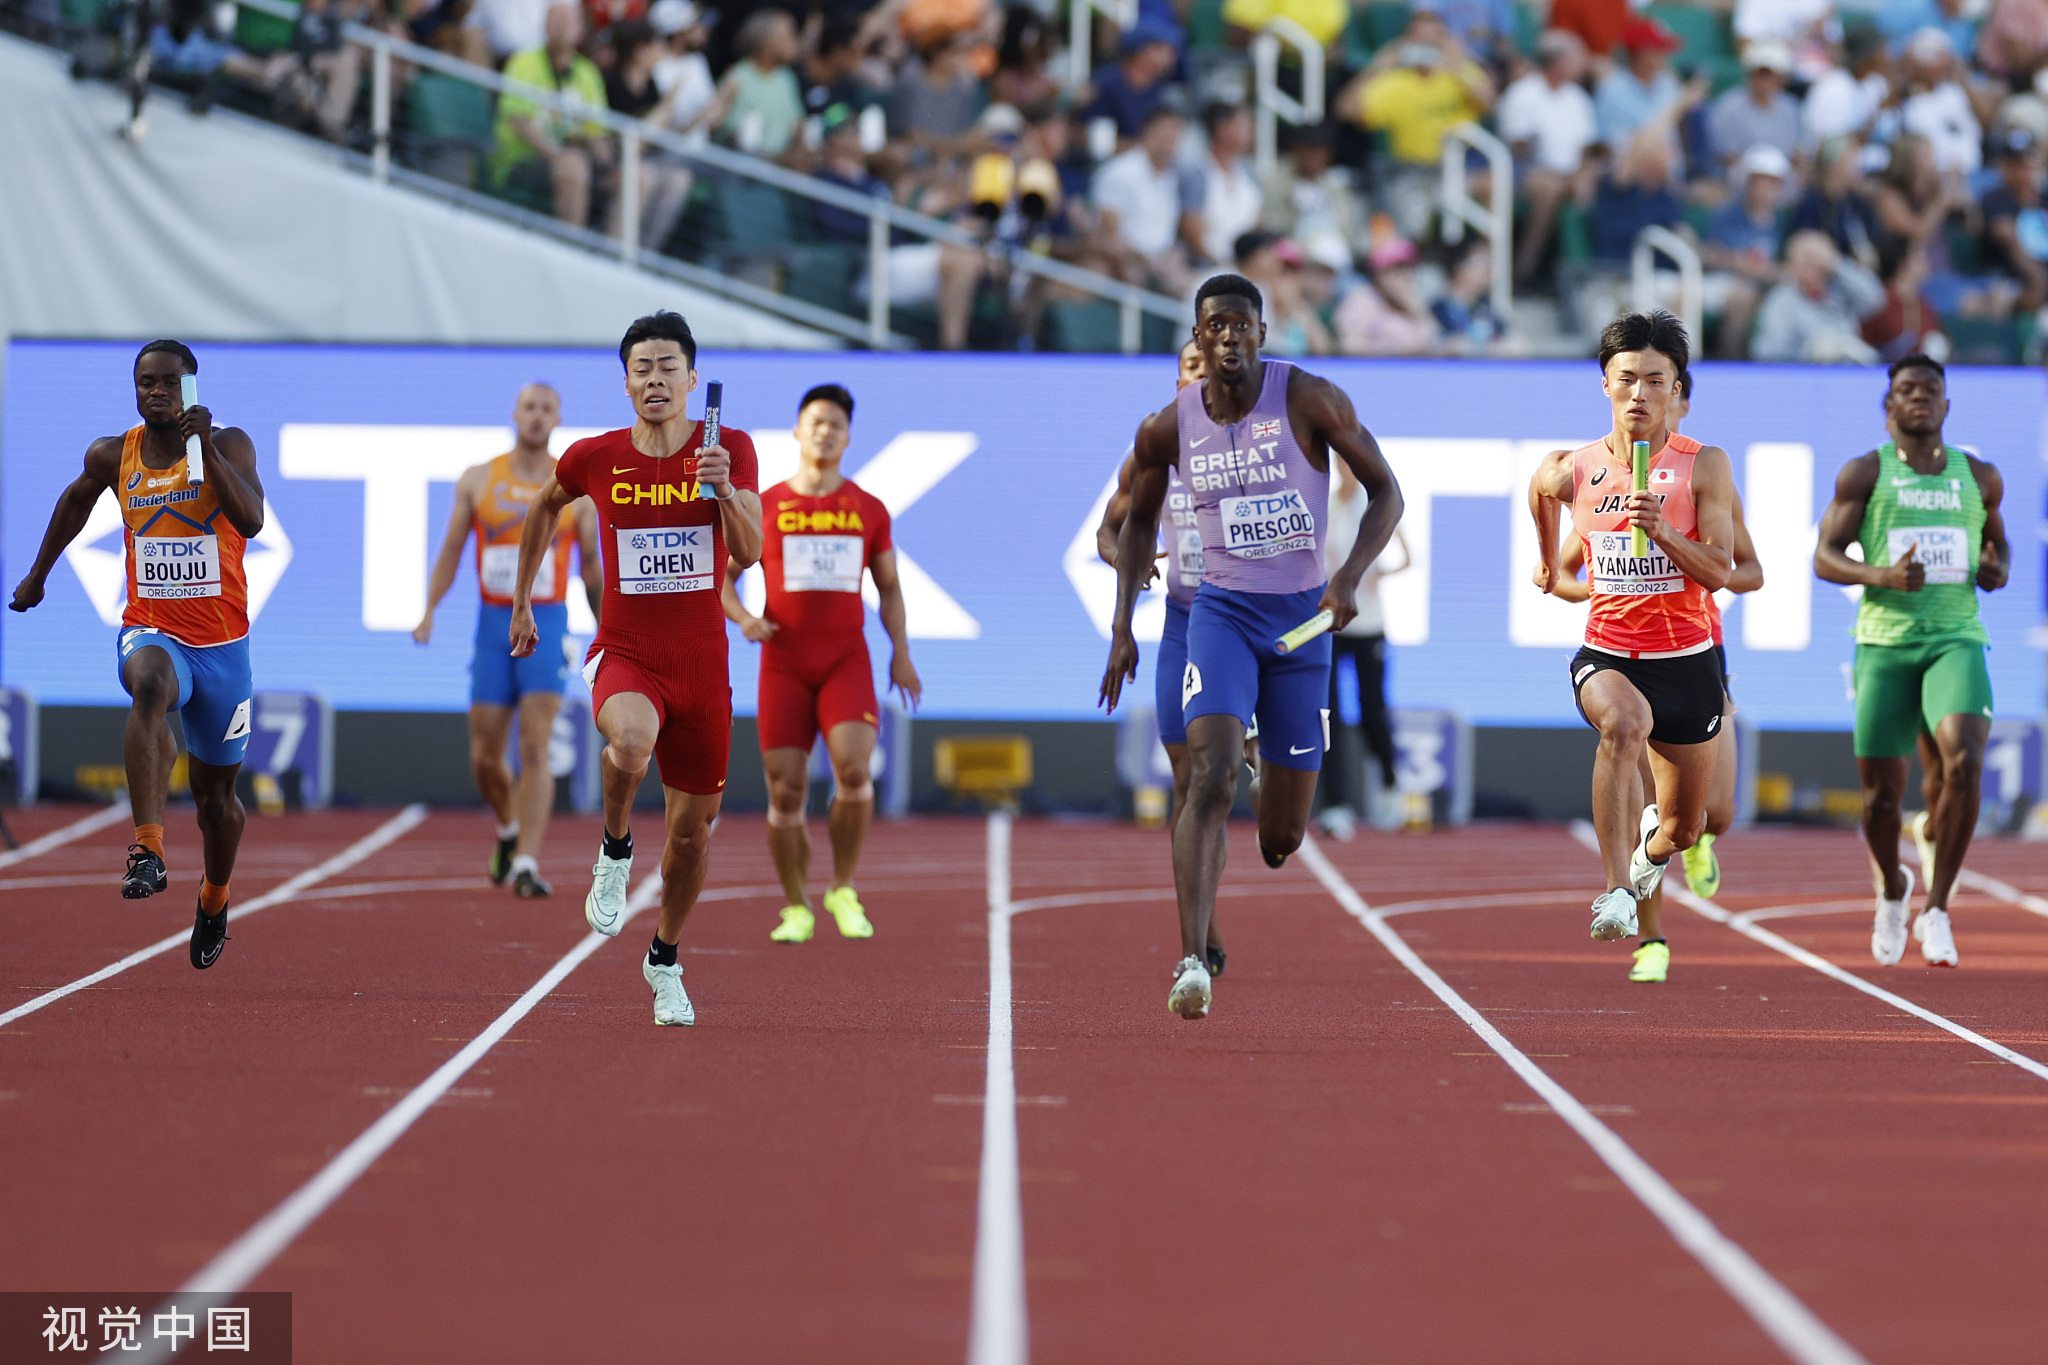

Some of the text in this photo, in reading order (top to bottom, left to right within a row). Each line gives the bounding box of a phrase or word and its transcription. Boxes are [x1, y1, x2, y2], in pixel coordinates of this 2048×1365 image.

[1190, 441, 1279, 473] GREAT
[1191, 463, 1287, 492] BRITAIN
[128, 485, 199, 509] Nederland
[1250, 493, 1301, 515] TDK
[1897, 487, 1962, 512] NIGERIA
[777, 510, 864, 533] CHINA
[1229, 513, 1313, 544] PRESCOD
[157, 540, 205, 557] TDK
[646, 530, 699, 549] TDK
[1244, 538, 1310, 559] OREGON22
[1916, 531, 1957, 546] TDK
[144, 561, 207, 582] BOUJU
[639, 553, 694, 575] CHEN
[1597, 556, 1678, 576] YANAGITA
[147, 587, 207, 598] OREGON22
[635, 579, 699, 592] OREGON22
[1606, 583, 1669, 593] OREGON22
[257, 713, 306, 774] 7
[1396, 733, 1448, 792] 3
[1987, 742, 2023, 800] 1
